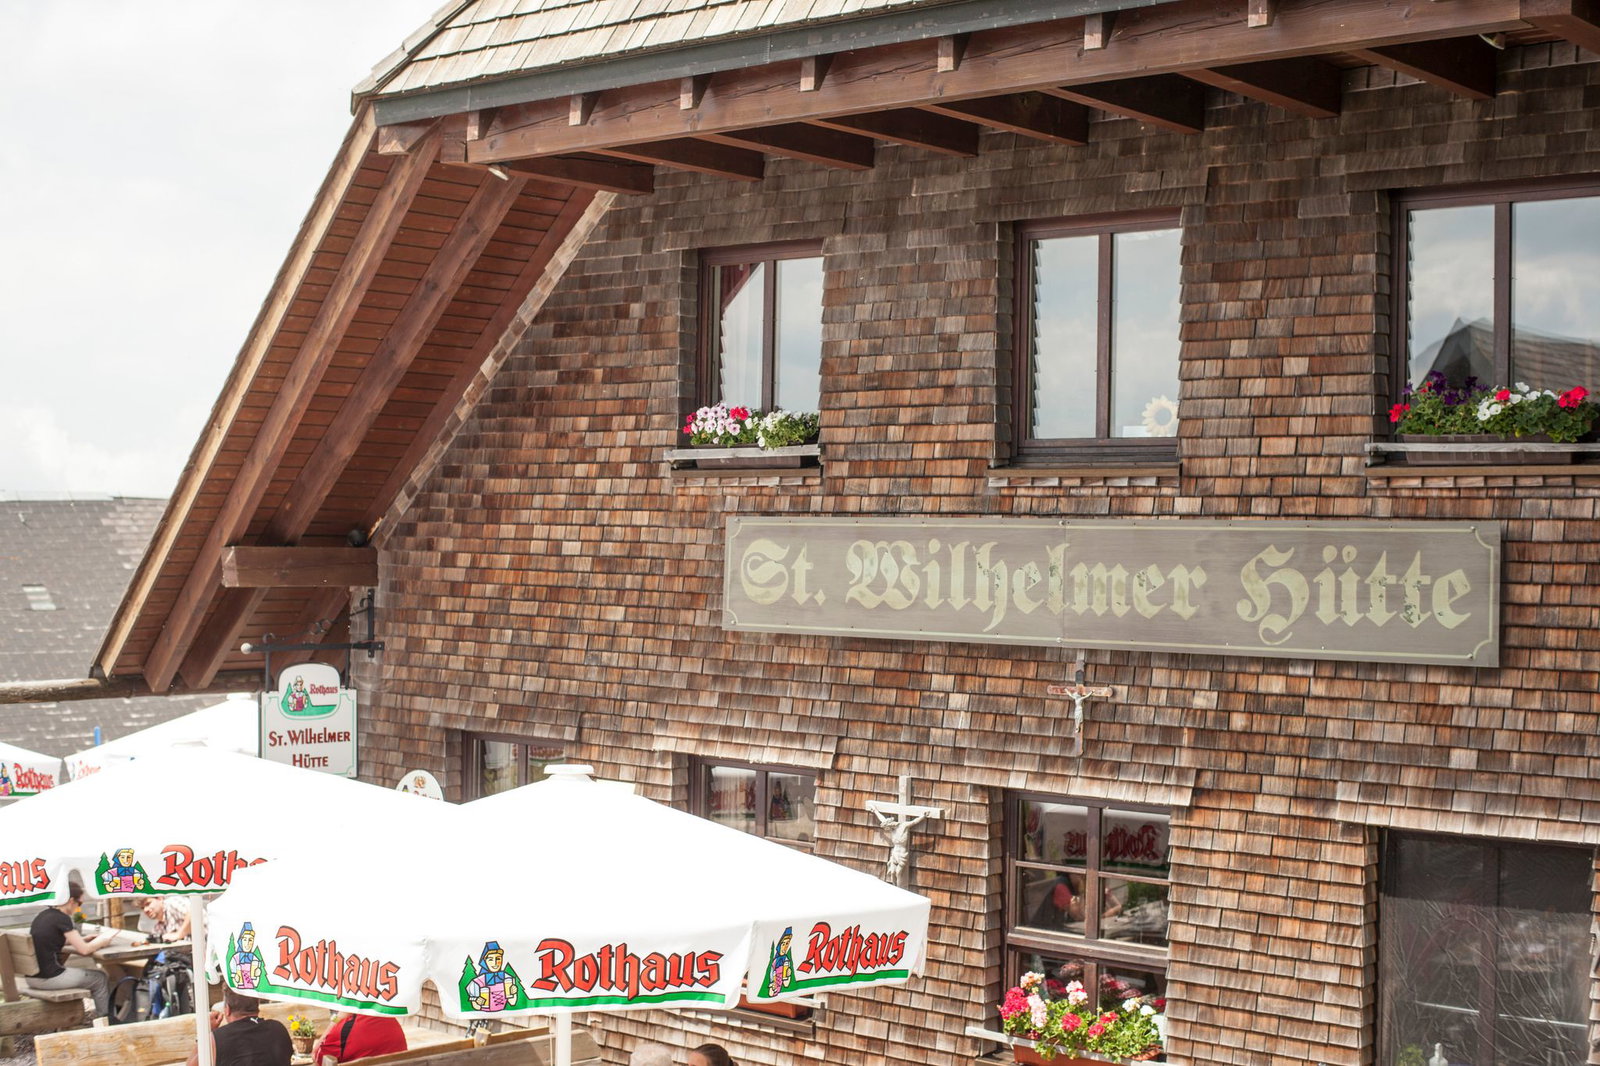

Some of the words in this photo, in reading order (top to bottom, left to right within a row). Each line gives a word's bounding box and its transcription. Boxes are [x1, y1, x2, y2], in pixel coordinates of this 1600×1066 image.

[740, 538, 826, 606] St.
[846, 538, 1207, 632] Wilhelmer
[1236, 544, 1472, 646] Hütte
[309, 683, 339, 696] Rothaus
[0, 857, 51, 895] aus
[156, 844, 268, 888] Roth
[273, 925, 401, 1001] Rothaus
[530, 938, 724, 1001] Rothaus
[796, 921, 910, 977] Rothaus
